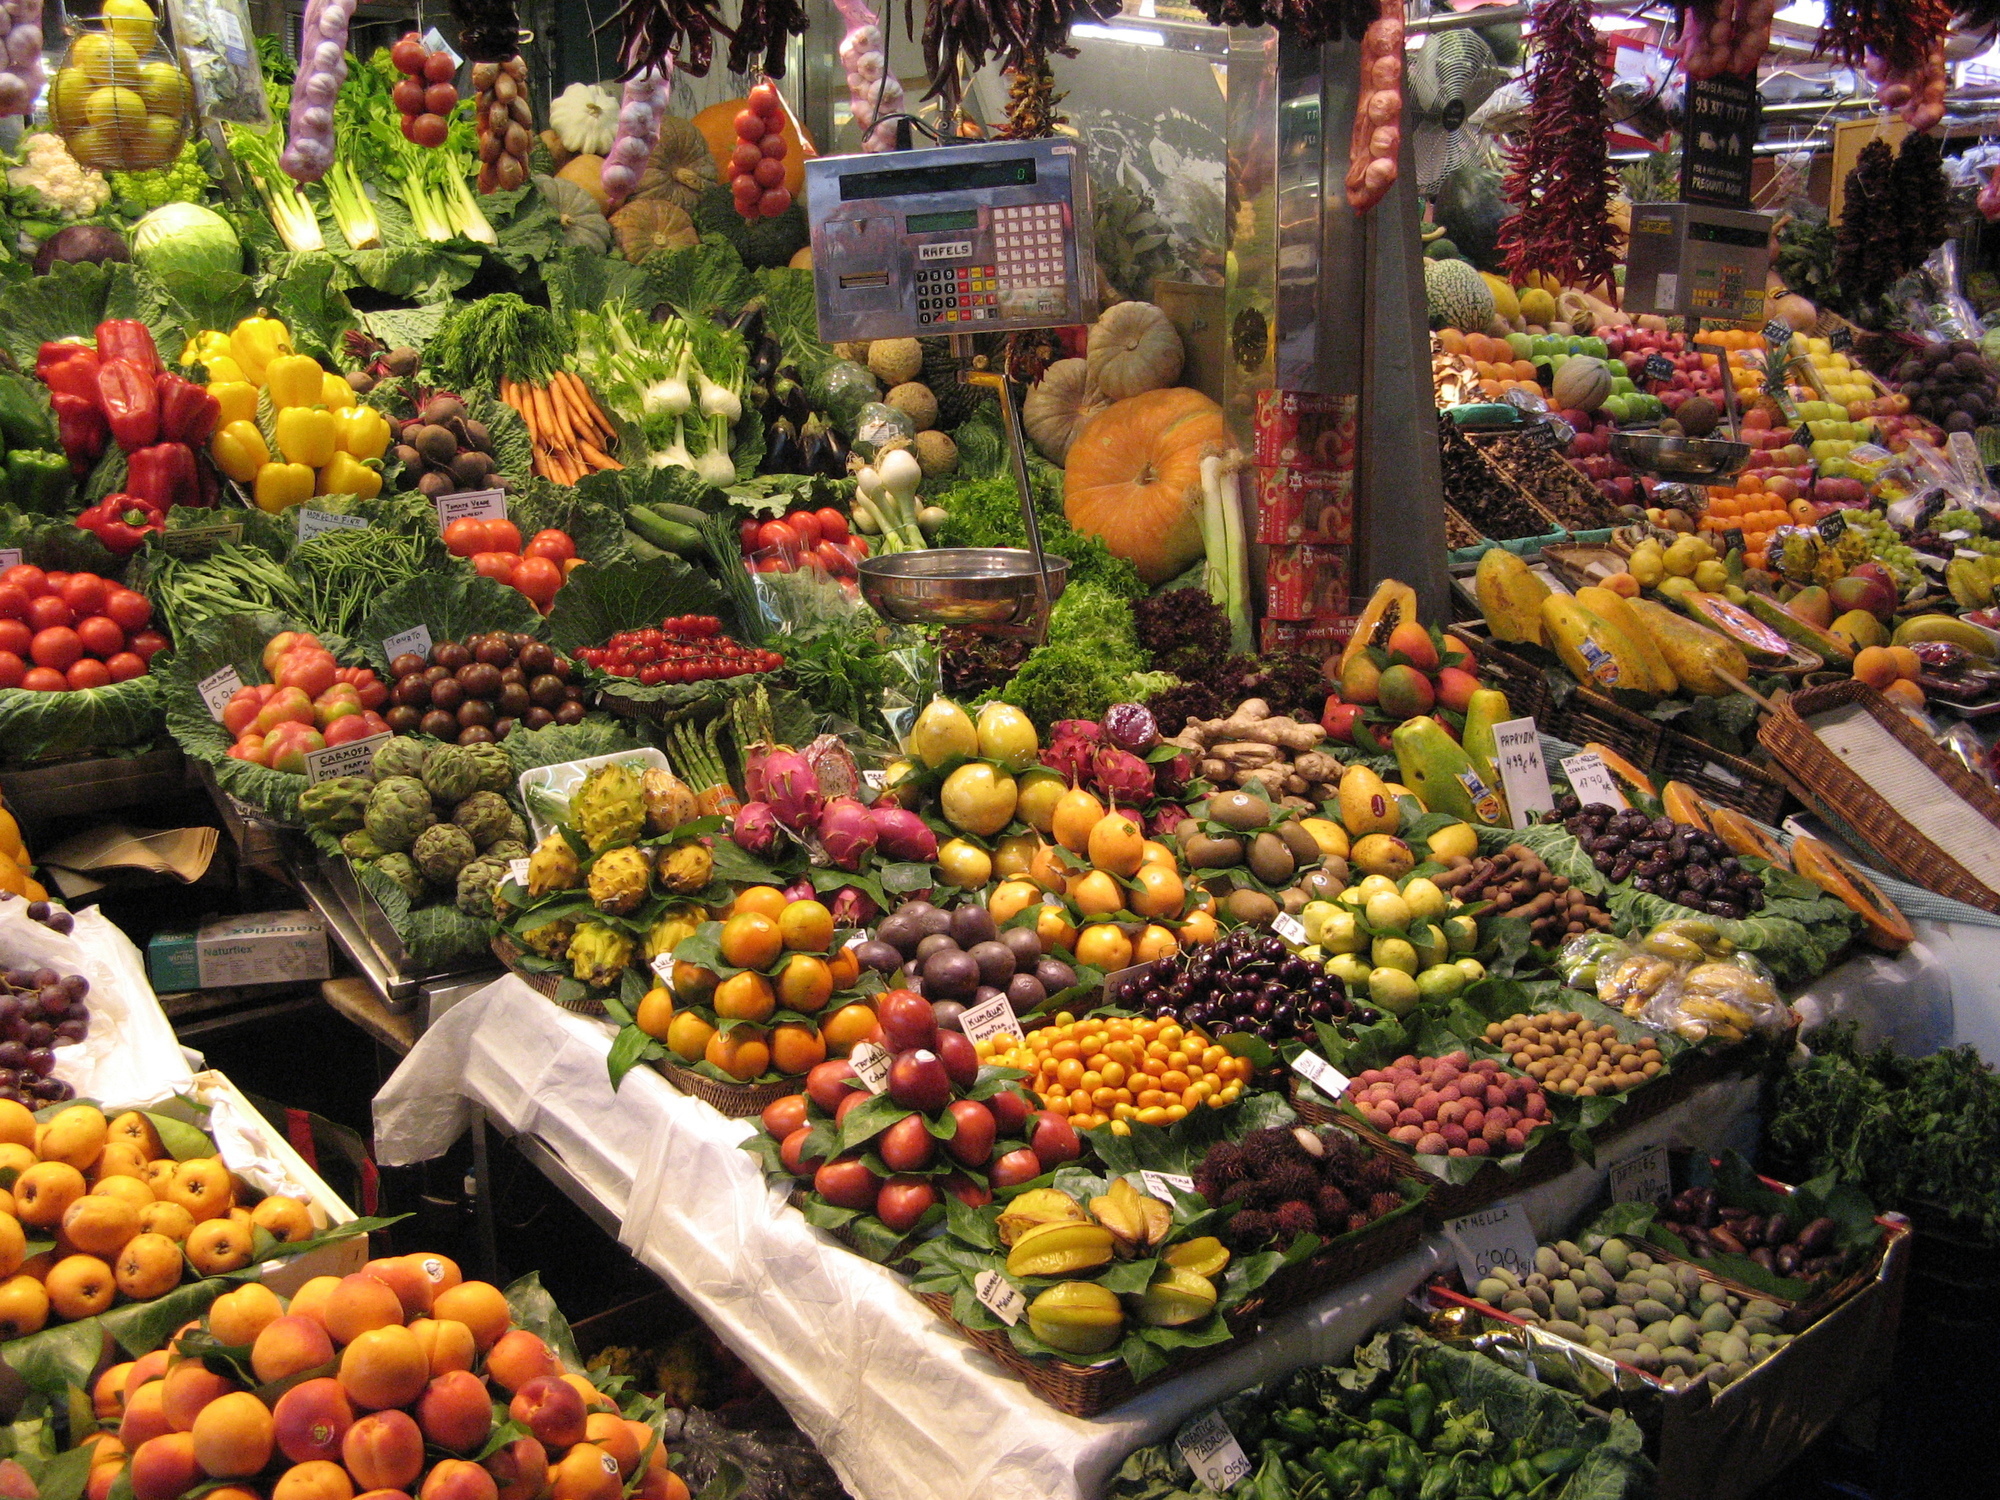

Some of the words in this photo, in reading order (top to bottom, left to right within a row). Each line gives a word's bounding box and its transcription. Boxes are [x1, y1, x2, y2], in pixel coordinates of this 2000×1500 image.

[921, 245, 969, 258] RAFELS
[319, 746, 372, 765] CARXOFA
[203, 946, 253, 957] Naturflex
[967, 1002, 1005, 1027] KUMQUAT
[1455, 1209, 1509, 1233] ATMELLA
